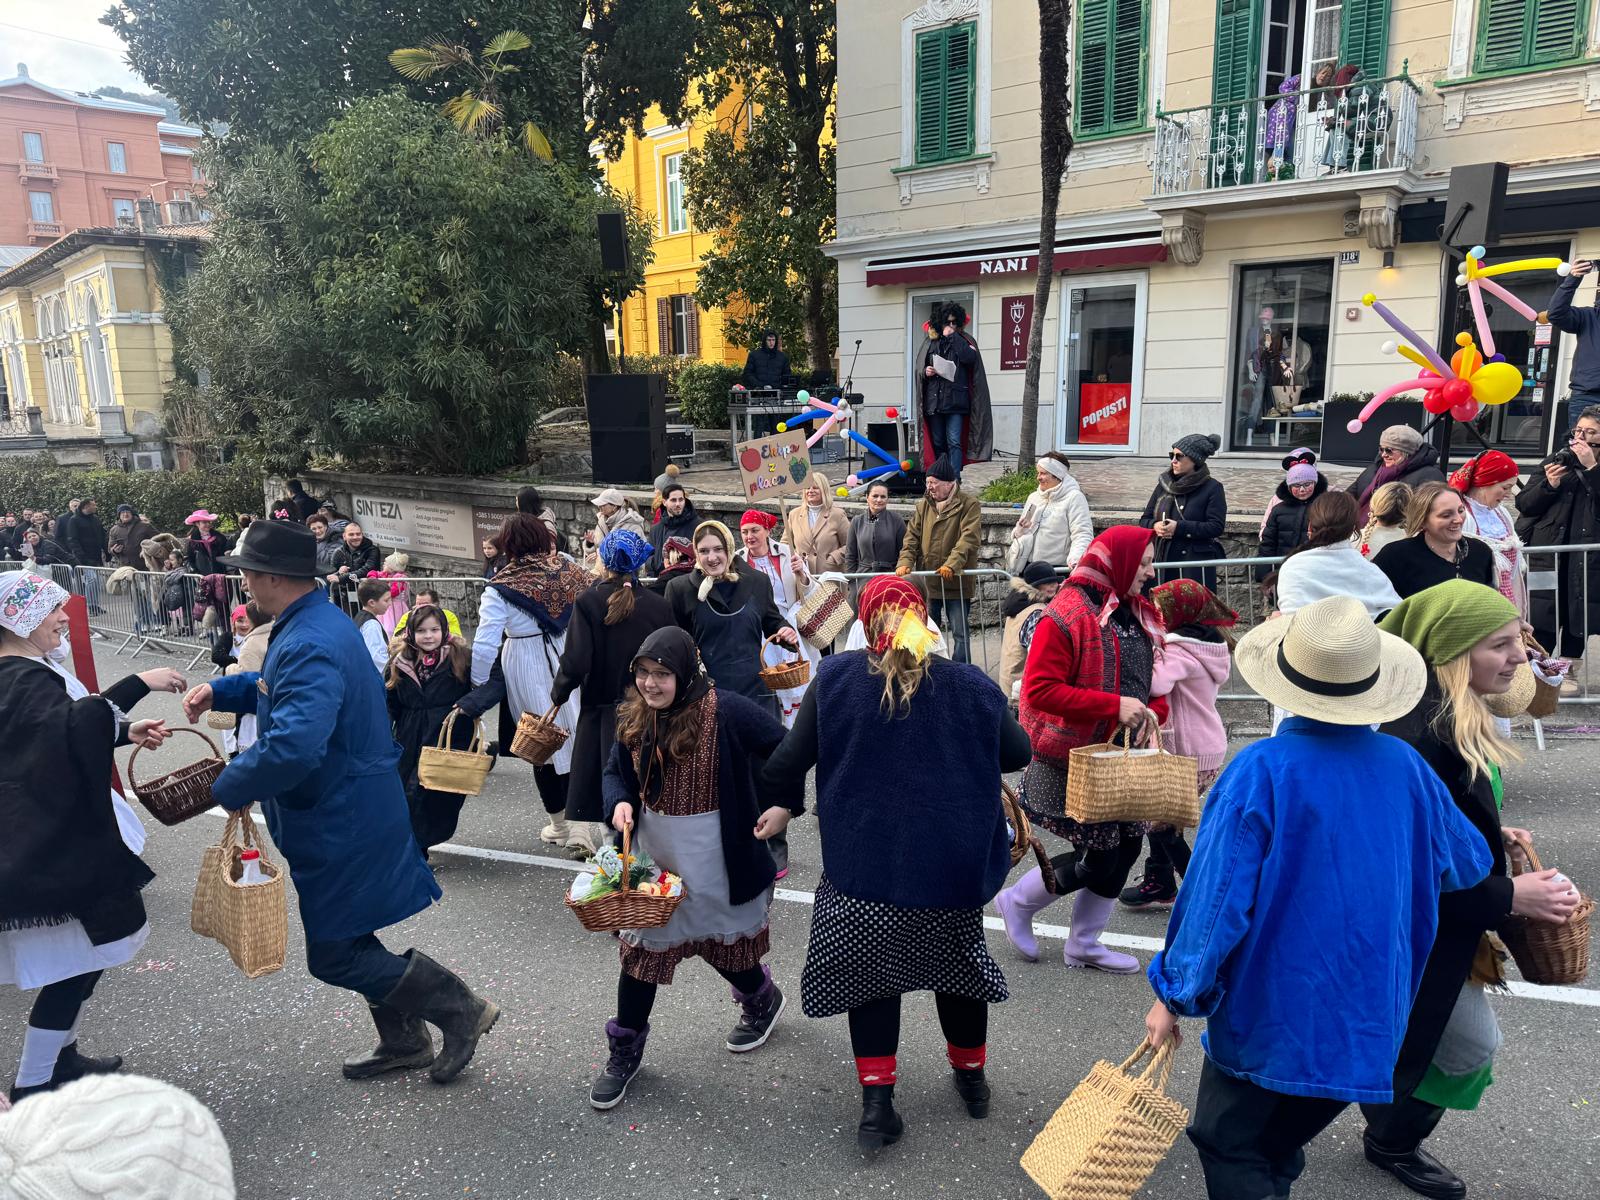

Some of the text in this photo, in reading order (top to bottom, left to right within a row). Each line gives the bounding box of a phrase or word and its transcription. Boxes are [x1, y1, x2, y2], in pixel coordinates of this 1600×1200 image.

[980, 257, 1028, 274] NANI
[1012, 308, 1022, 359] NANI
[1082, 395, 1127, 429] POPUSTI
[761, 442, 800, 460] Ekipa
[749, 475, 788, 497] placa
[356, 499, 403, 521] SINTEZA
